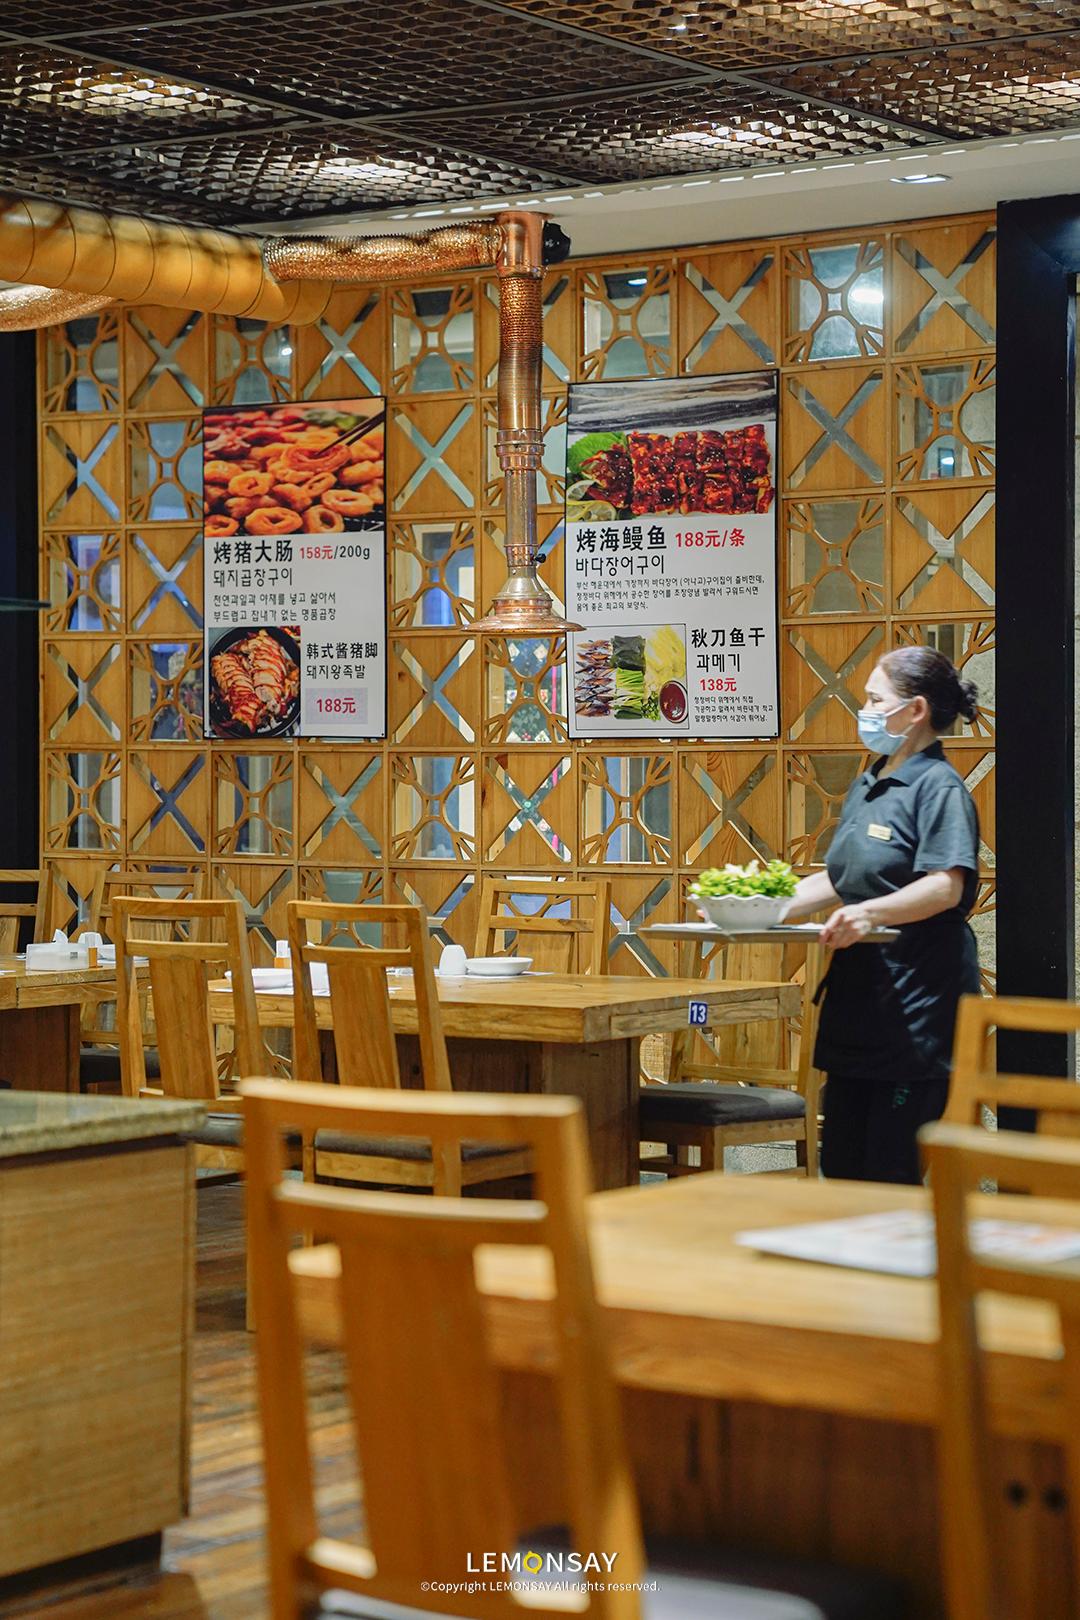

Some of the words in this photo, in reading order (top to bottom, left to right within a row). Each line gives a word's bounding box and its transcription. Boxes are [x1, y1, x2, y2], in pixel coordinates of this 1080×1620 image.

[576, 525, 667, 553] 烤海鳗鱼
[675, 528, 745, 548] 188元/条
[213, 540, 293, 565] 烤猪大肠
[300, 545, 370, 560] 158元/200g
[576, 555, 665, 577] 바다장어구이
[213, 567, 293, 588] 돼지곱창구이
[213, 610, 247, 623] 부드럽고
[251, 609, 277, 622] 잡내가
[281, 609, 297, 622] 없는
[302, 608, 336, 621] 명품곱창
[691, 628, 765, 648] 秋刀鱼干
[306, 642, 378, 659] 韩式酱猪脚
[306, 664, 366, 680] 돼지왕족발
[696, 653, 740, 673] 과메기
[700, 678, 737, 692] 138元
[316, 697, 356, 714] 188元
[691, 1004, 706, 1023] 13
